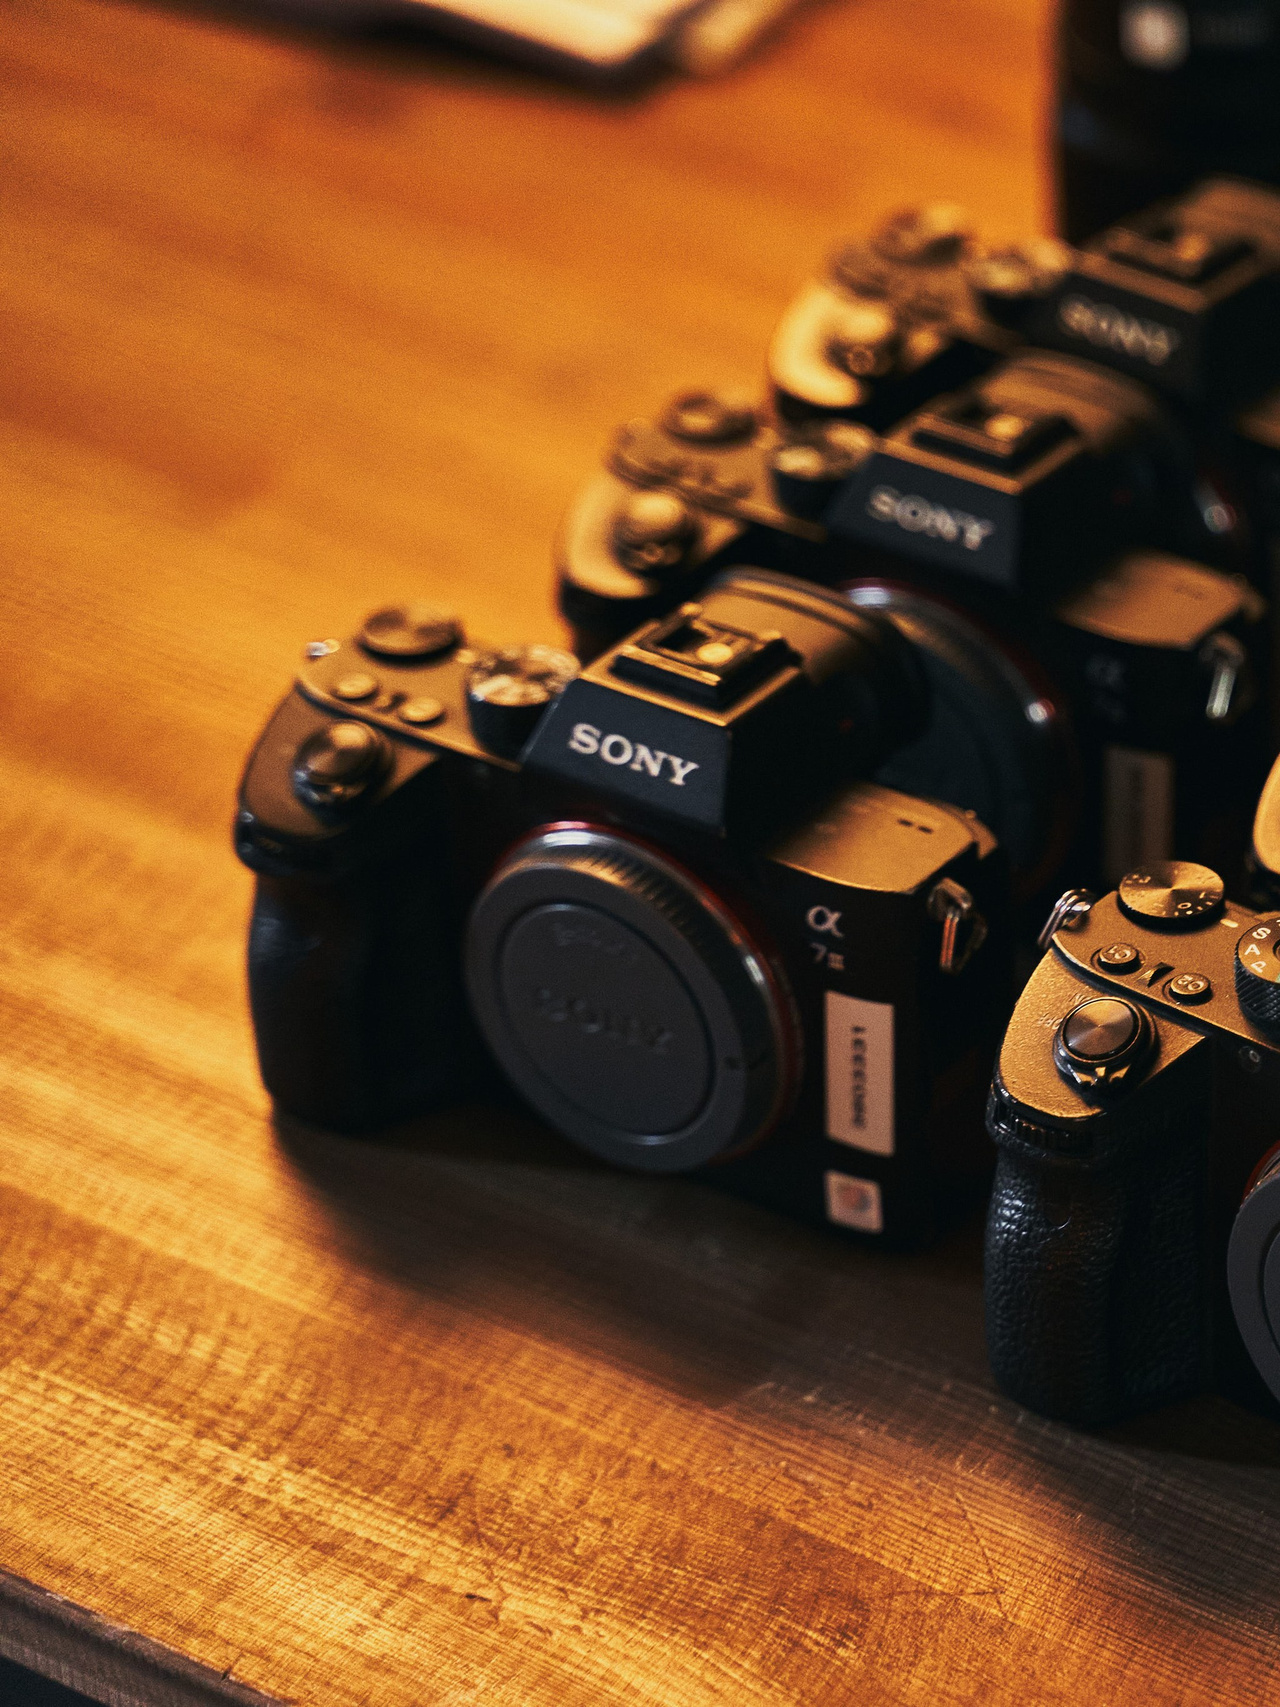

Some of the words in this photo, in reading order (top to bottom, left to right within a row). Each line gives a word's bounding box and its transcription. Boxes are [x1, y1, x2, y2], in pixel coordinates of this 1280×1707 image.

[866, 484, 996, 551] SONY
[567, 722, 700, 786] SONY
[1252, 927, 1271, 939] S
[1244, 943, 1261, 956] A
[1250, 961, 1267, 973] P
